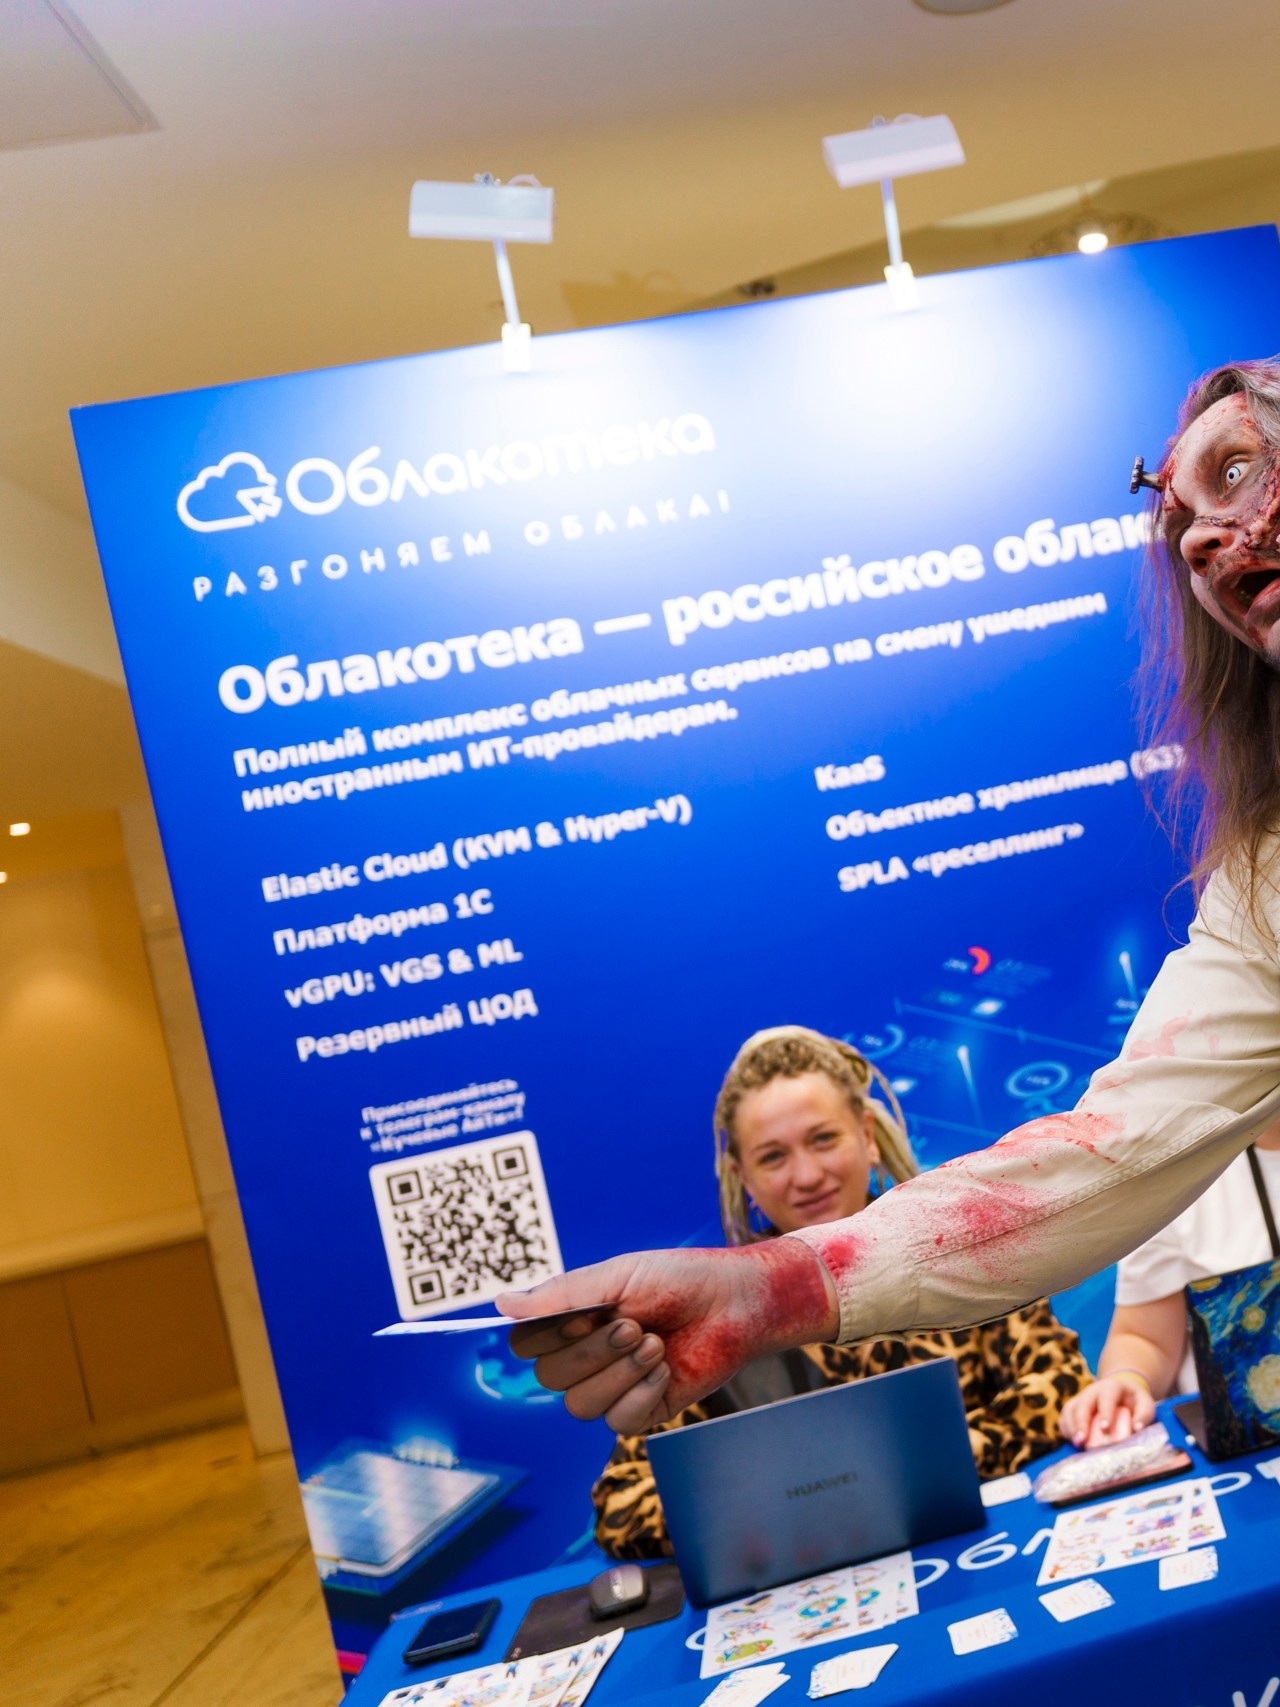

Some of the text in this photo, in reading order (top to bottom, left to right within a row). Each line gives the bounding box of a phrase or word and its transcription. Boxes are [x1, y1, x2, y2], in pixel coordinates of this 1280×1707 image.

[286, 413, 716, 515] Облакотека
[193, 530, 491, 601] РАЗГОНЯЕМ
[219, 617, 584, 714] Облакотека
[662, 543, 985, 646] российское
[993, 511, 1166, 574] облак
[233, 592, 1106, 778] Полный комплекс облачных сервисов на смену ушедшим
[242, 699, 739, 812] иностранным ИТ-провайдерам.
[825, 792, 975, 841] Объектное
[977, 759, 1128, 811] хранилище
[261, 793, 693, 903] Elastic Cloud (KVM & Hyper-V)
[837, 856, 909, 892] SPLA
[273, 900, 448, 955] Платформа
[285, 938, 523, 1008] vGPU: VGS & ML
[296, 988, 539, 1063] Резервный ЦОД
[785, 1470, 858, 1500] HUAWEI
